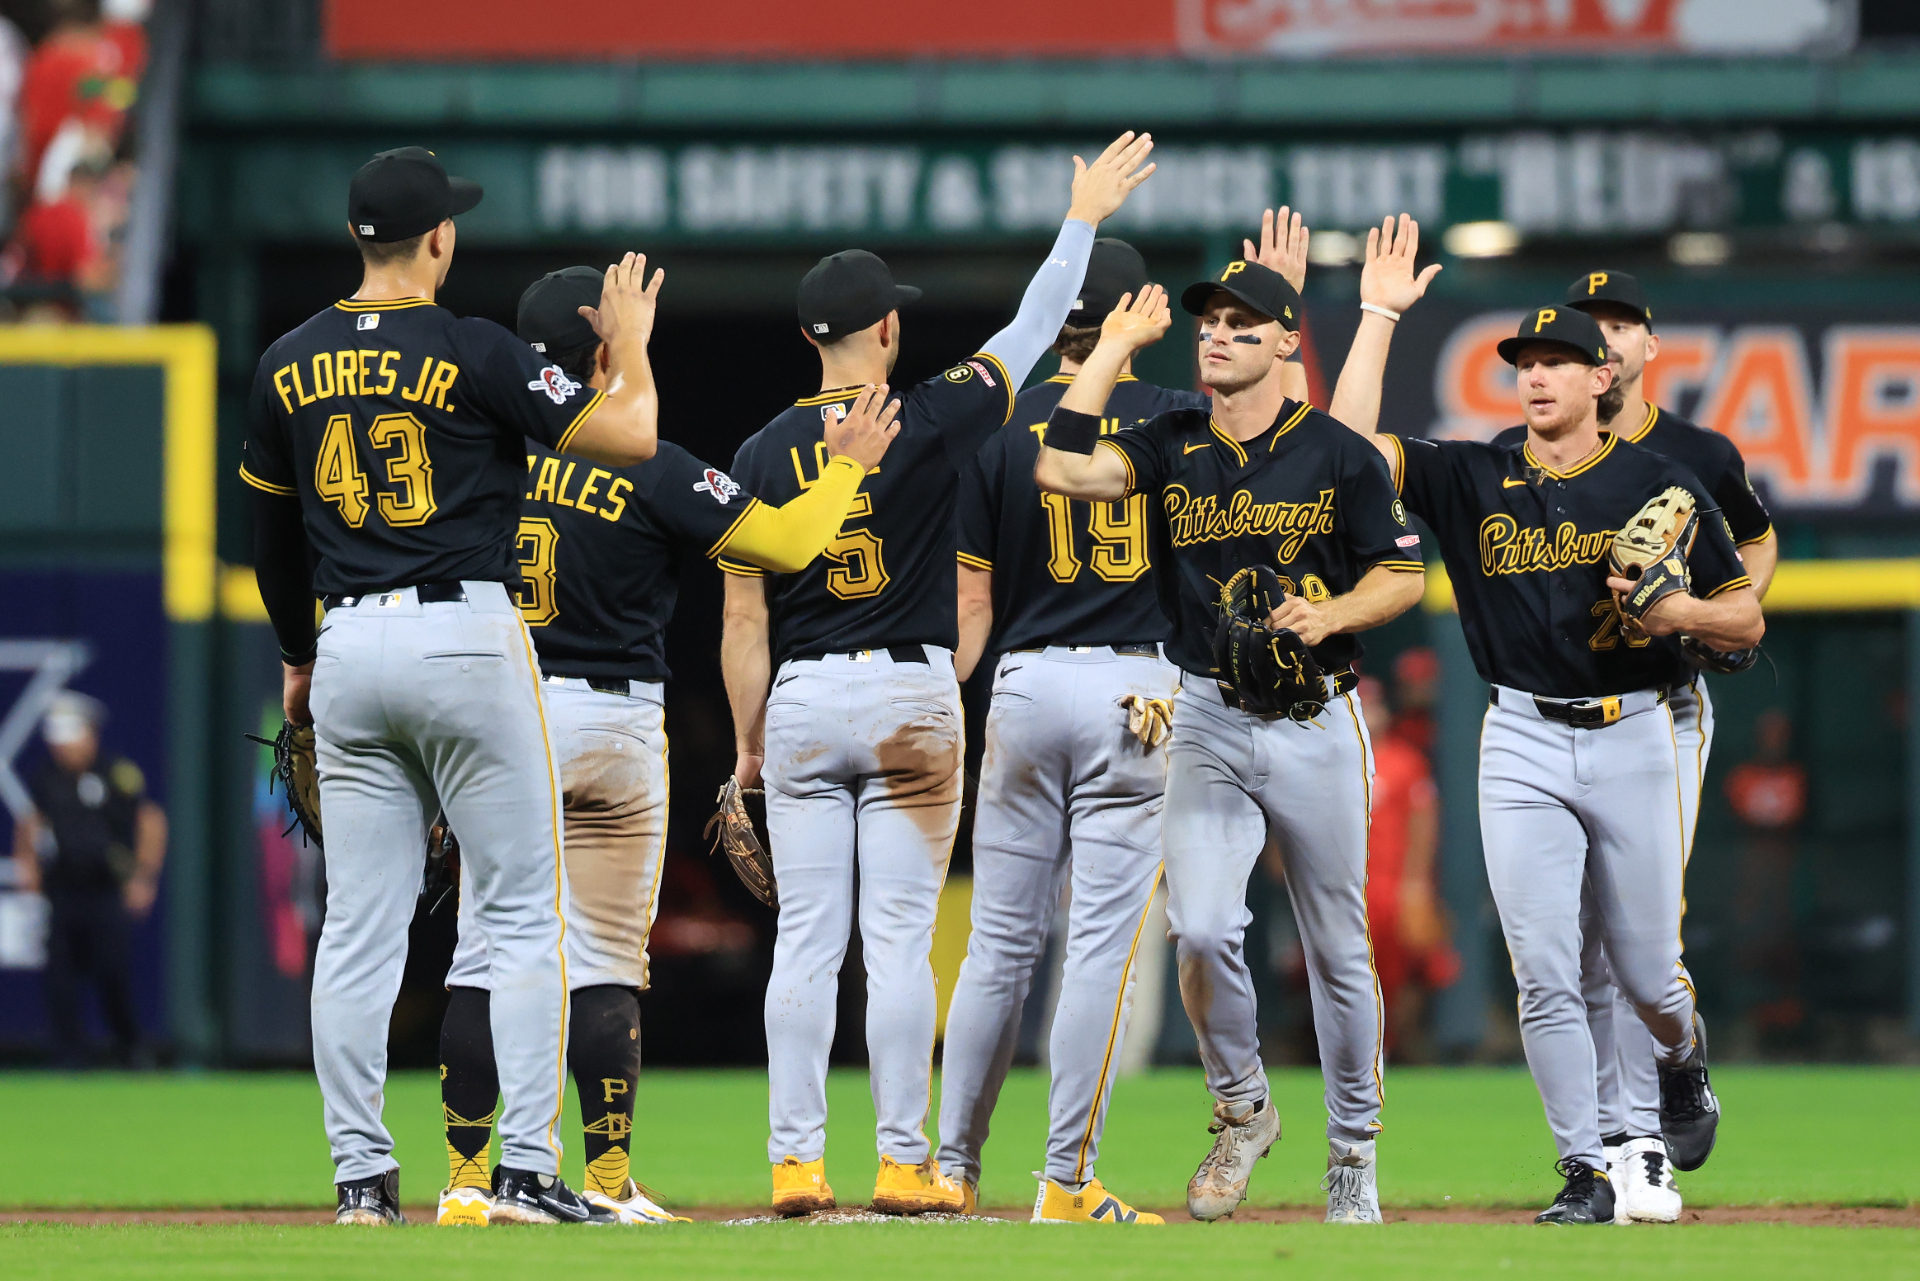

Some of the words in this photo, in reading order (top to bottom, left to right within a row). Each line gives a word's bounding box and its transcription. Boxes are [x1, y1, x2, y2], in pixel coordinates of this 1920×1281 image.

[1221, 261, 1246, 282] P
[1588, 272, 1609, 295] P
[1534, 309, 1557, 333] P
[273, 350, 401, 415] FLORES
[401, 356, 460, 413] JR.
[315, 412, 438, 528] 43
[822, 492, 891, 600] 5
[1041, 491, 1151, 583] 19
[1163, 484, 1336, 565] Pittsburgh
[1633, 573, 1667, 606] Wilson
[601, 1078, 628, 1103] P
